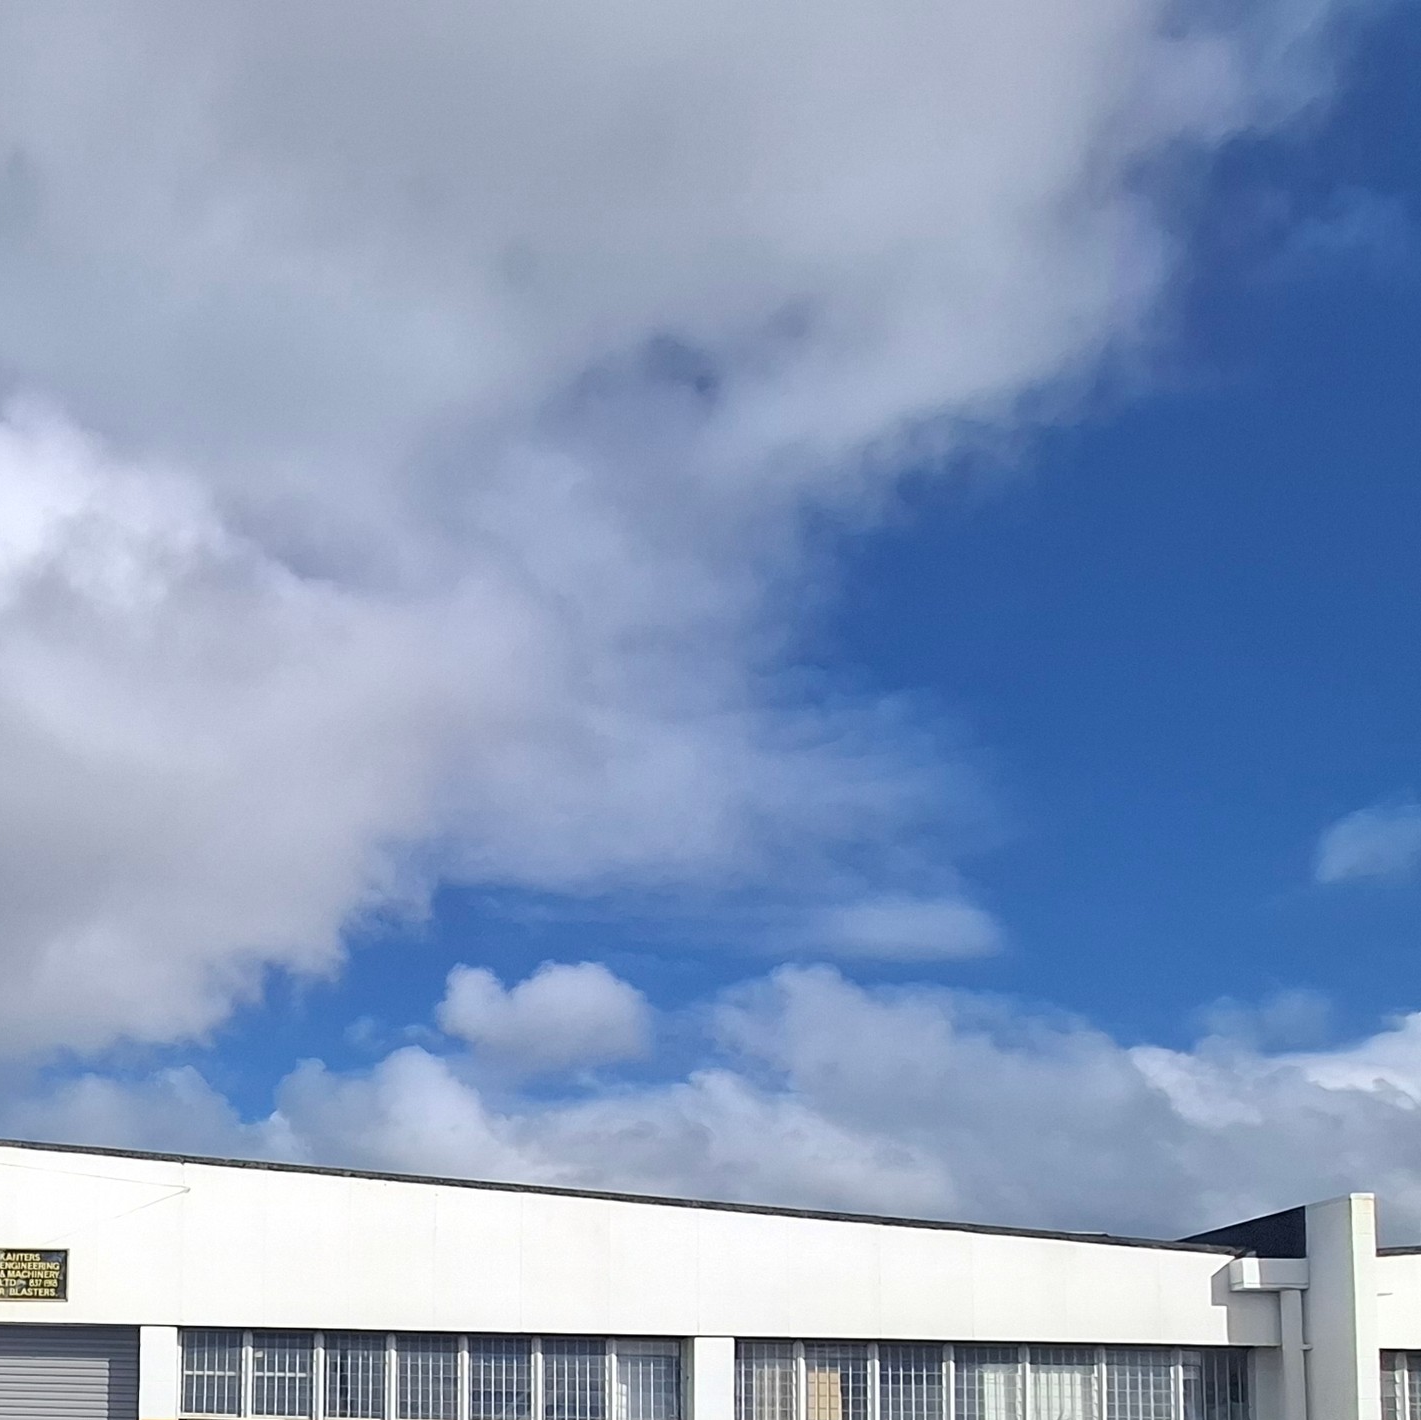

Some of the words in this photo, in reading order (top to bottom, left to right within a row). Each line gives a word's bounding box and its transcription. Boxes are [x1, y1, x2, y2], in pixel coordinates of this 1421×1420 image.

[0, 1253, 41, 1261] KANTERS
[0, 1262, 60, 1270] ENGINEERING
[7, 1271, 60, 1279] MACHINERY
[0, 1279, 17, 1287] LTD
